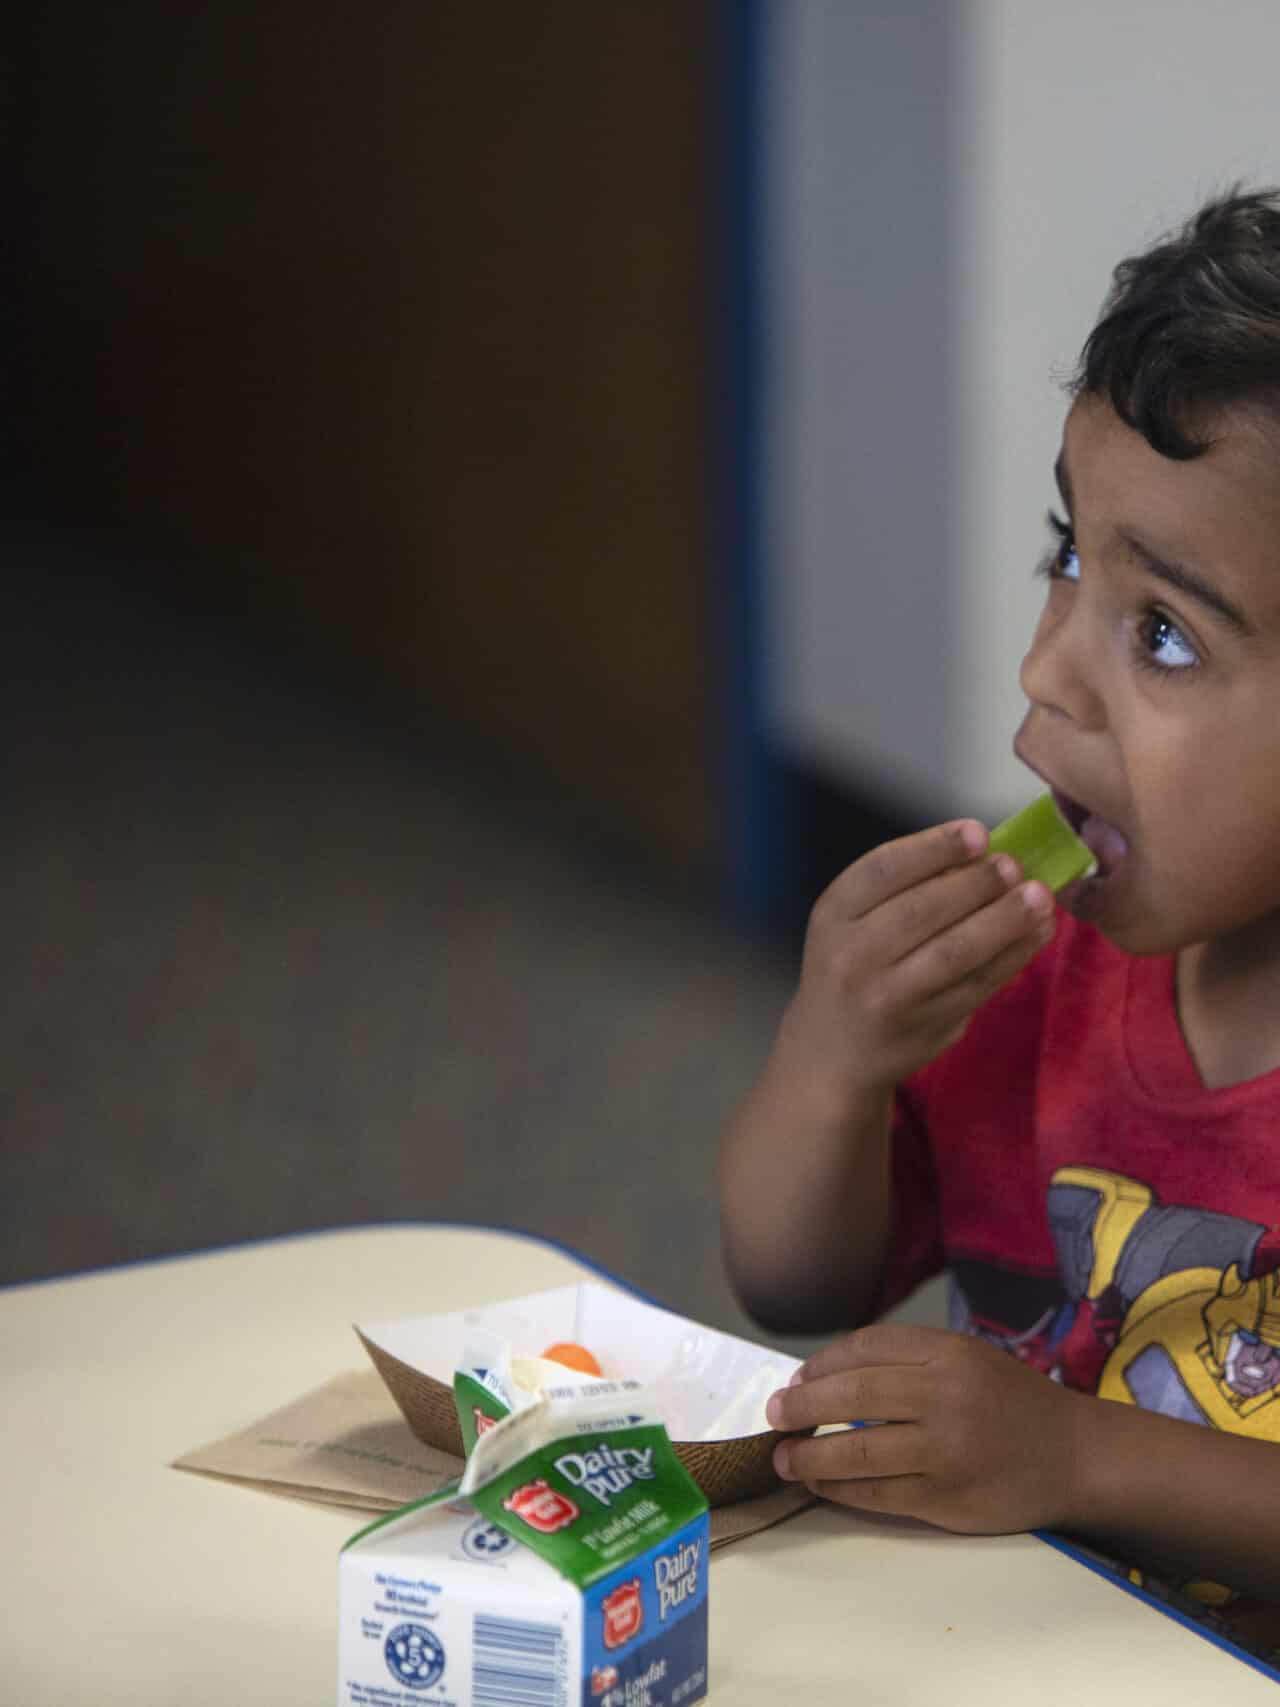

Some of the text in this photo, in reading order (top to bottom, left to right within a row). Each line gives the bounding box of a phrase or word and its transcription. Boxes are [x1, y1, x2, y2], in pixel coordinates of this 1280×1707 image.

[554, 1443, 653, 1486] Dairy
[654, 1537, 702, 1591] Dairy
[625, 1659, 667, 1698] Lowfat
